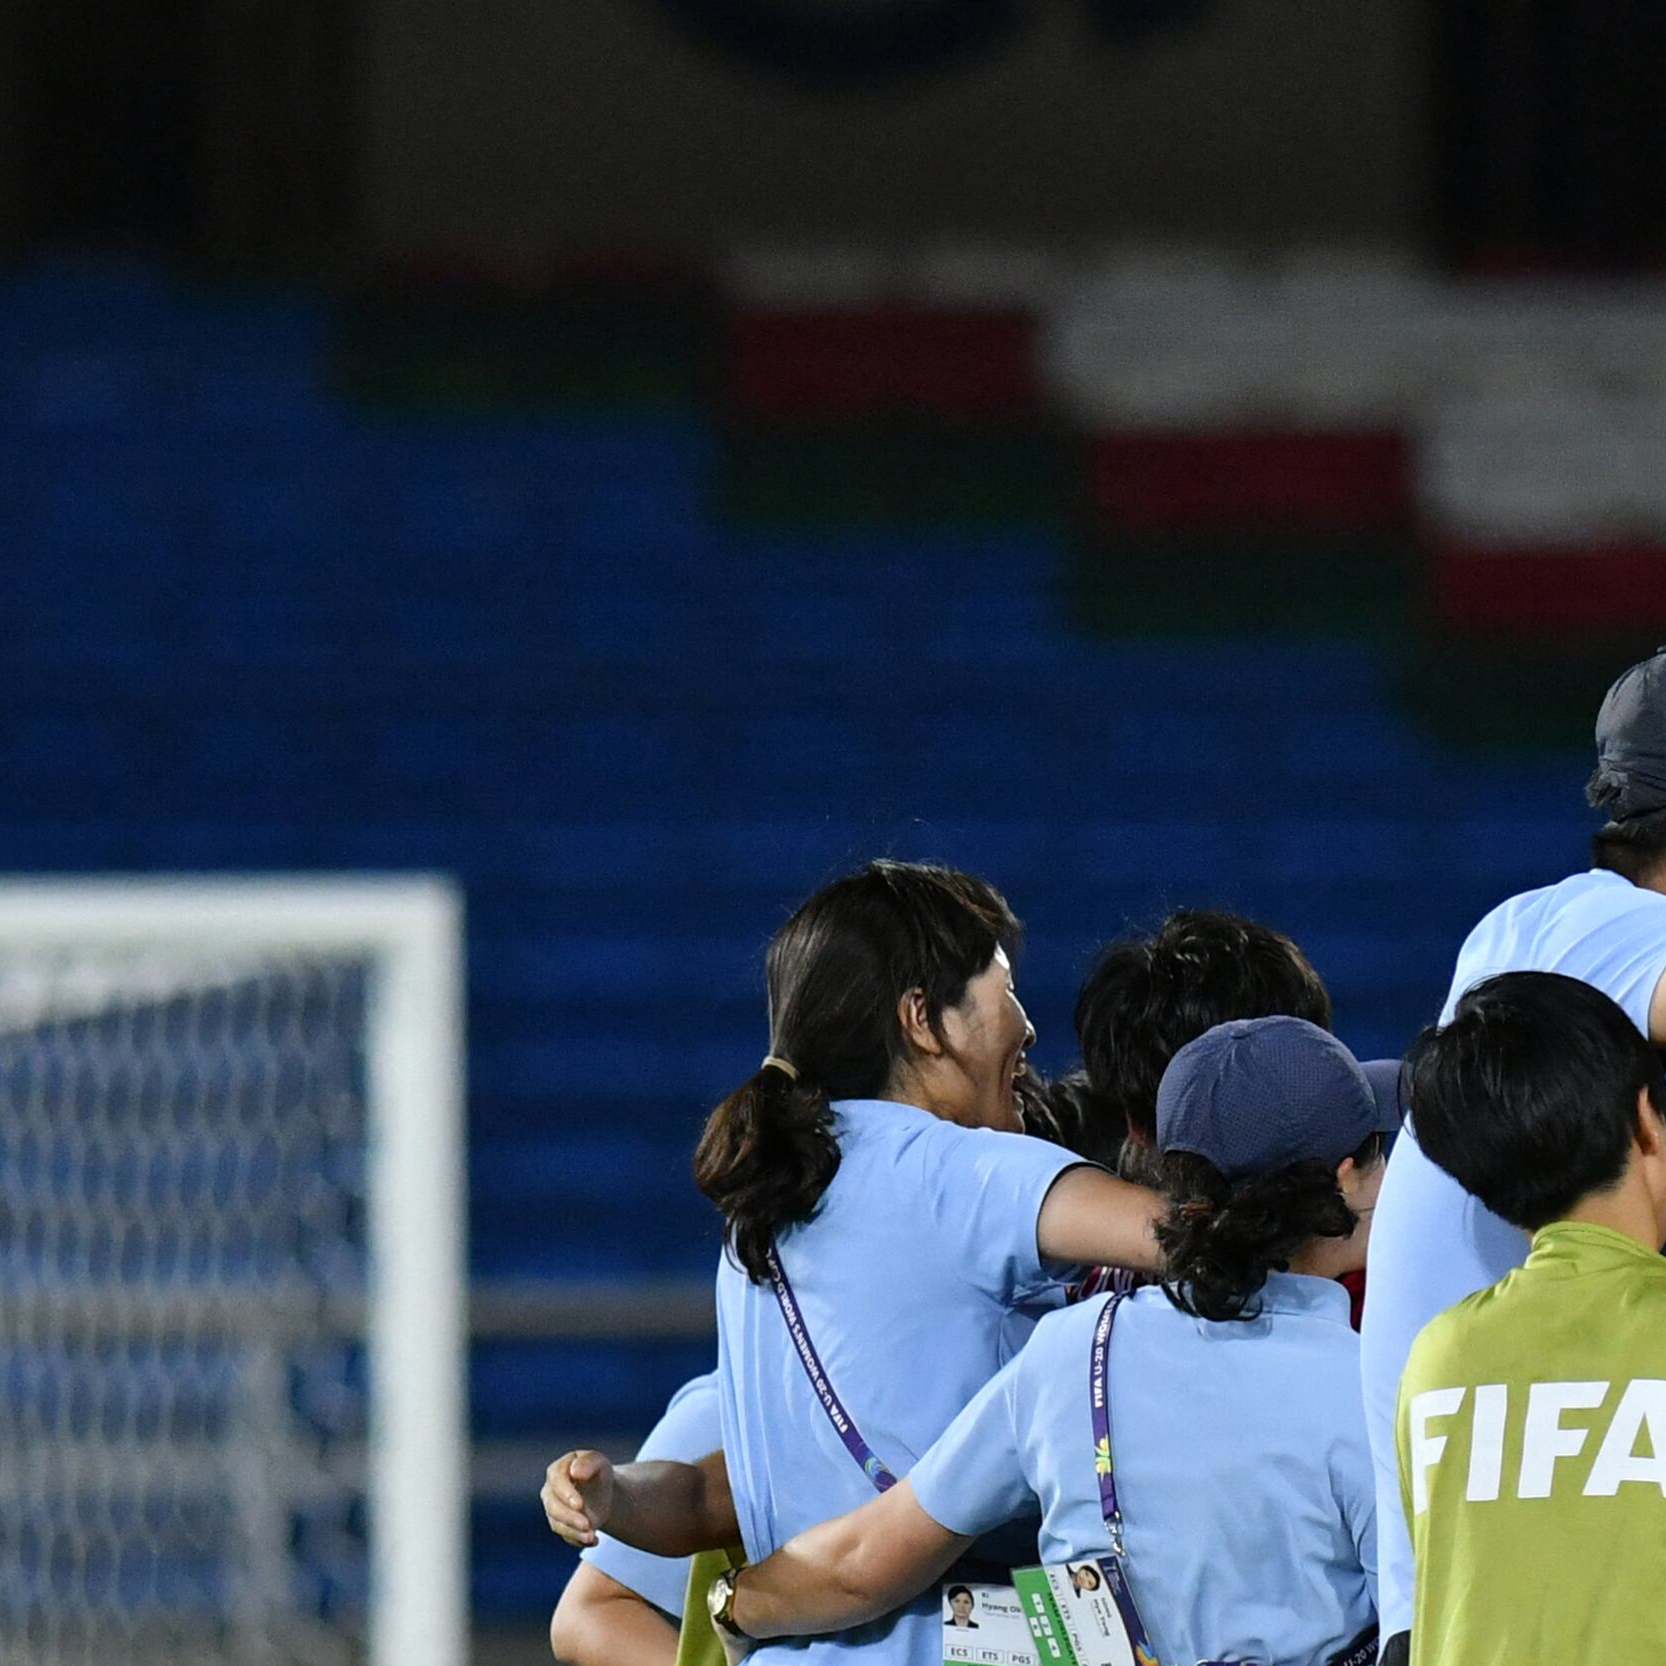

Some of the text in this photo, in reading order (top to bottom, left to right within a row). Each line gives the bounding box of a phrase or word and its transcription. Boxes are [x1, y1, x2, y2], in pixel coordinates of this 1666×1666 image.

[777, 1281, 797, 1325] WORLD
[792, 1322, 820, 1381] WOMEN'S
[1093, 1347, 1104, 1375] U-20
[816, 1378, 833, 1406] U-20
[1093, 1377, 1103, 1409] FIFA
[829, 1404, 849, 1434] FIFA
[981, 1602, 1008, 1613] Hyang
[950, 1647, 1031, 1665] ECS ETS PGS
